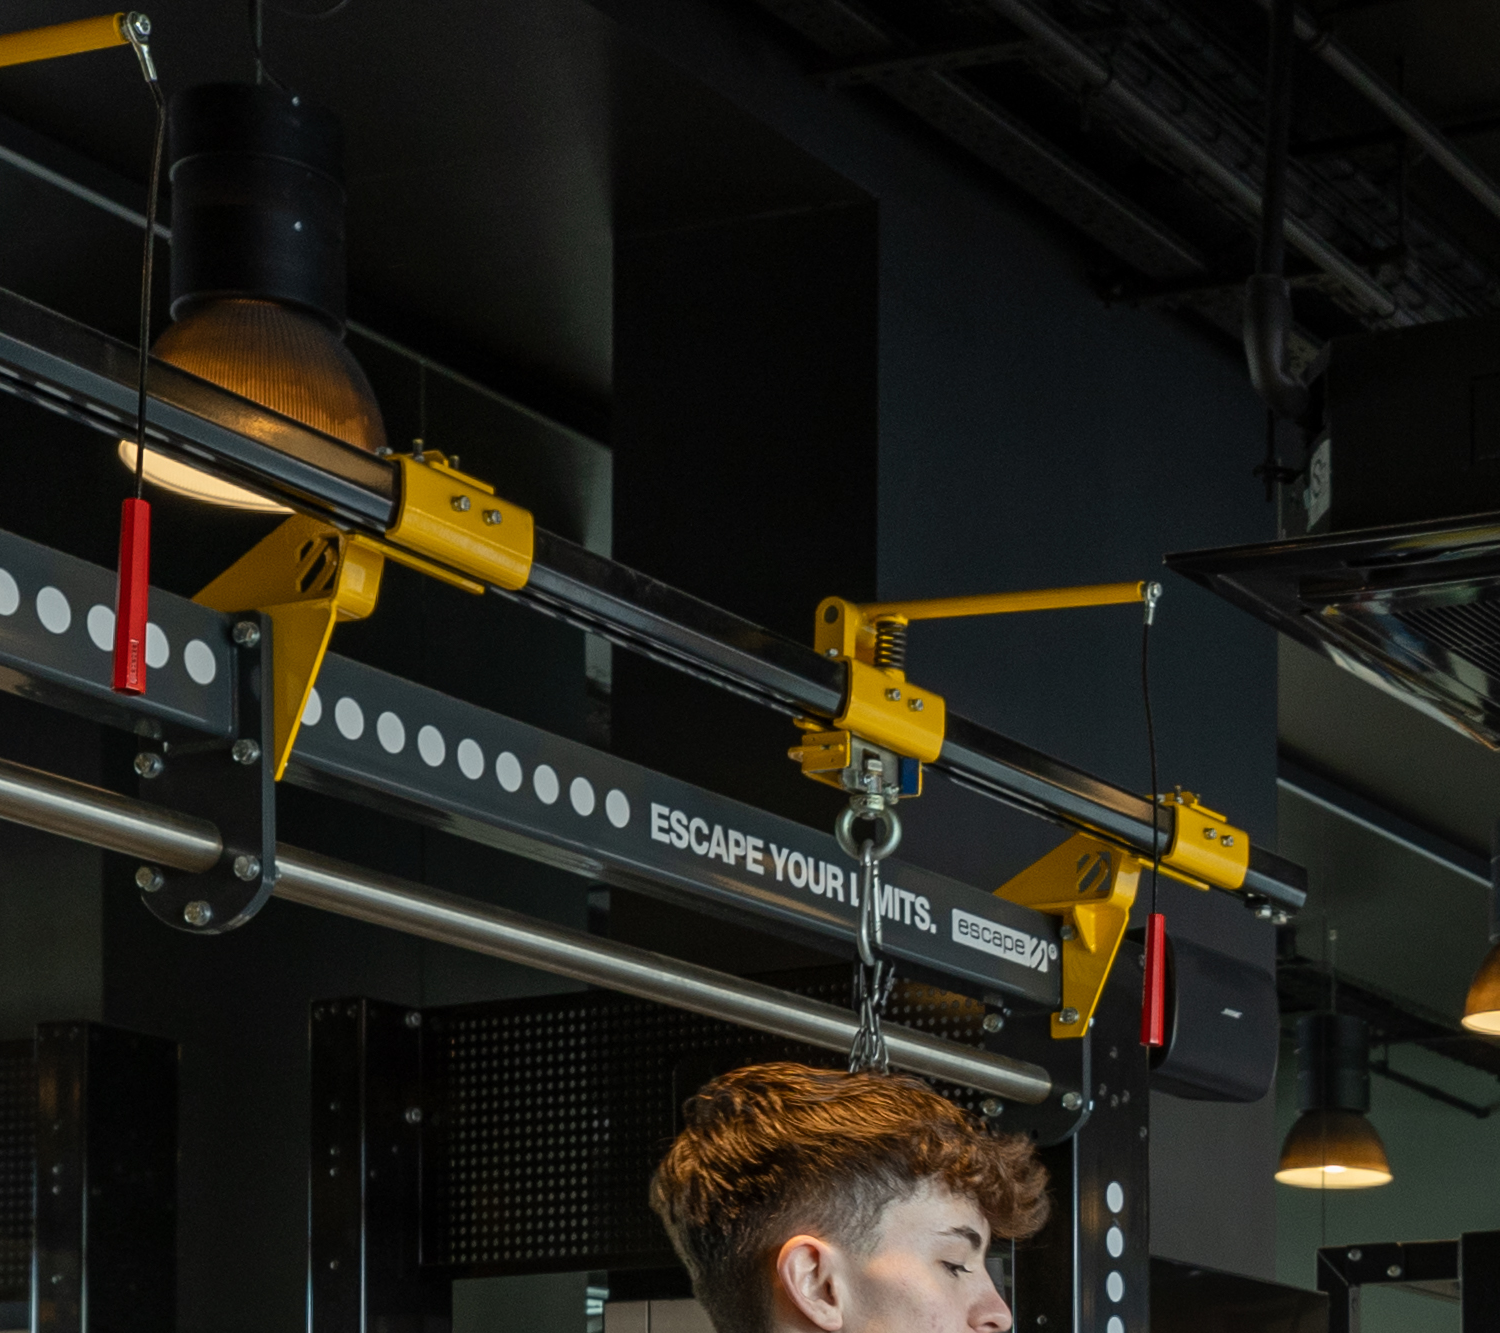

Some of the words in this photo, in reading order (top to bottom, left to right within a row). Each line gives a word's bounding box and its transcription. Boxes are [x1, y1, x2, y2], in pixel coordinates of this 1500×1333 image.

[650, 802, 766, 876] ESCAPE
[769, 843, 845, 902] YOUR
[850, 871, 937, 934] LMITS.
[958, 915, 1026, 957] escape
